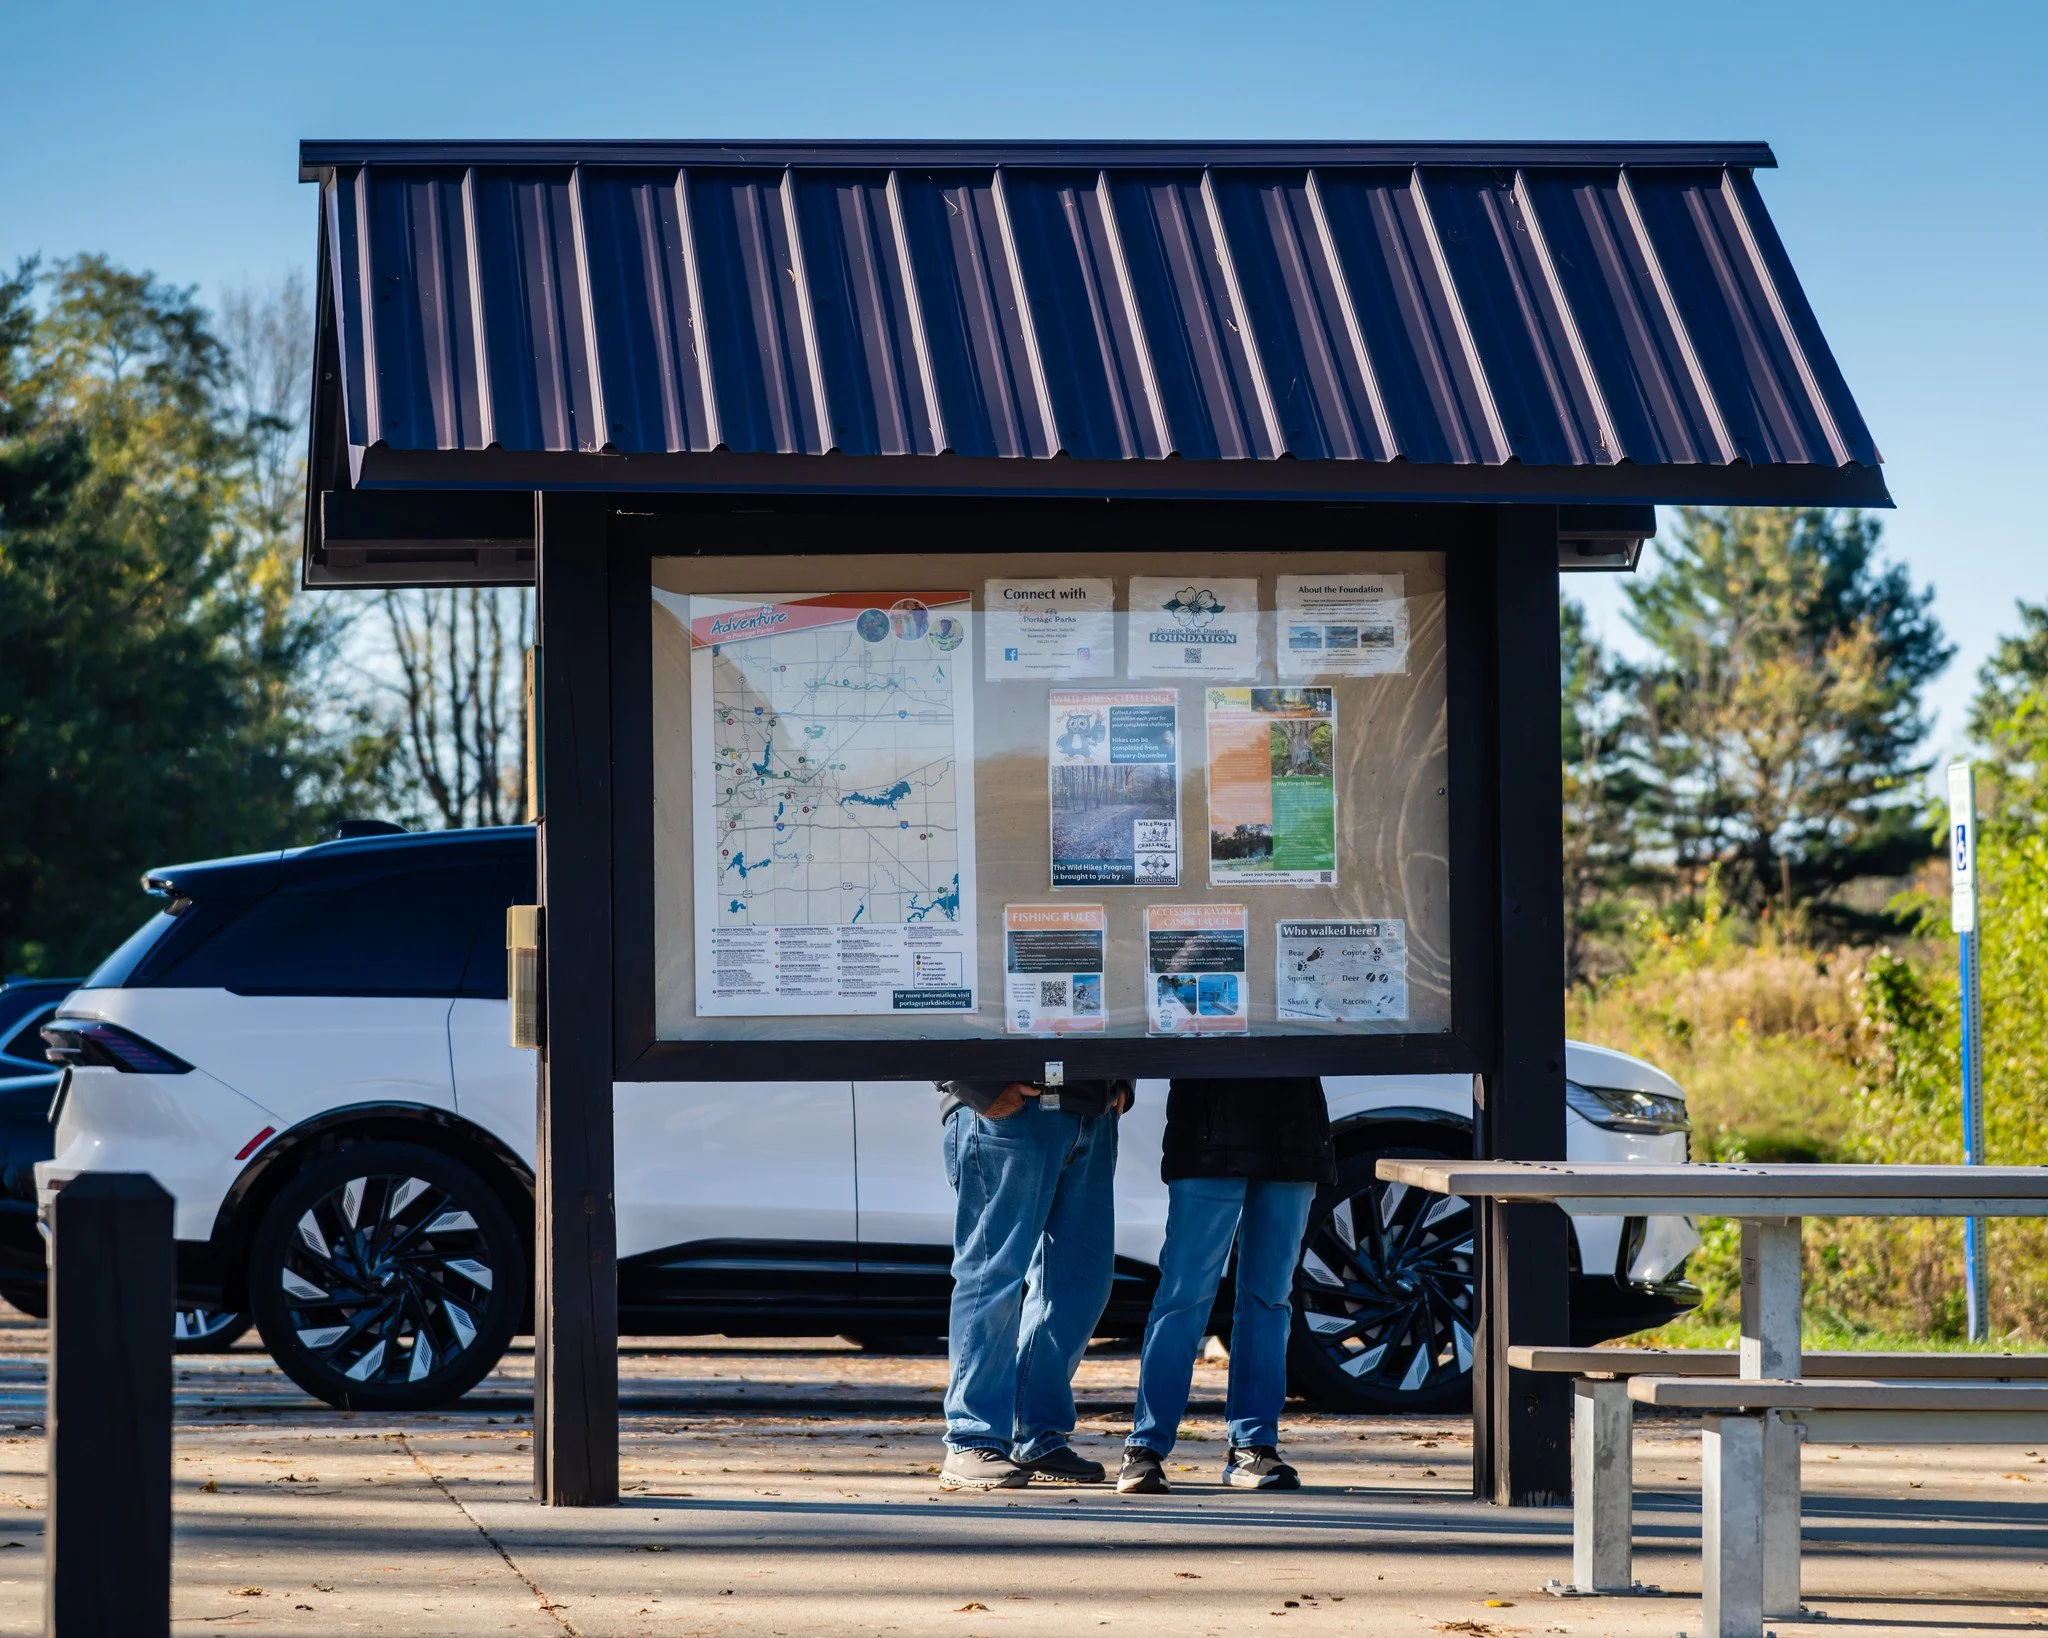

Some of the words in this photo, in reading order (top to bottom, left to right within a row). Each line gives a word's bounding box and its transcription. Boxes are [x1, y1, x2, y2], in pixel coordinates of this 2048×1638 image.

[1003, 588, 1056, 600] Connect
[1060, 587, 1086, 599] with
[1299, 586, 1322, 594] About
[710, 611, 788, 635] Adventure
[1023, 616, 1053, 624] Portage
[1152, 634, 1235, 643] FOUNDATION
[1111, 752, 1168, 760] January-December
[1103, 864, 1133, 872] Program
[1060, 873, 1088, 881] brought
[1111, 873, 1121, 881] by
[1150, 908, 1202, 916] ACCESSIBLE
[1012, 912, 1059, 922] FISHING
[1062, 911, 1097, 922] RULES
[1283, 926, 1308, 936] Who
[1310, 926, 1347, 936] walked
[1349, 926, 1378, 936] here?
[1342, 949, 1367, 957] Coyote
